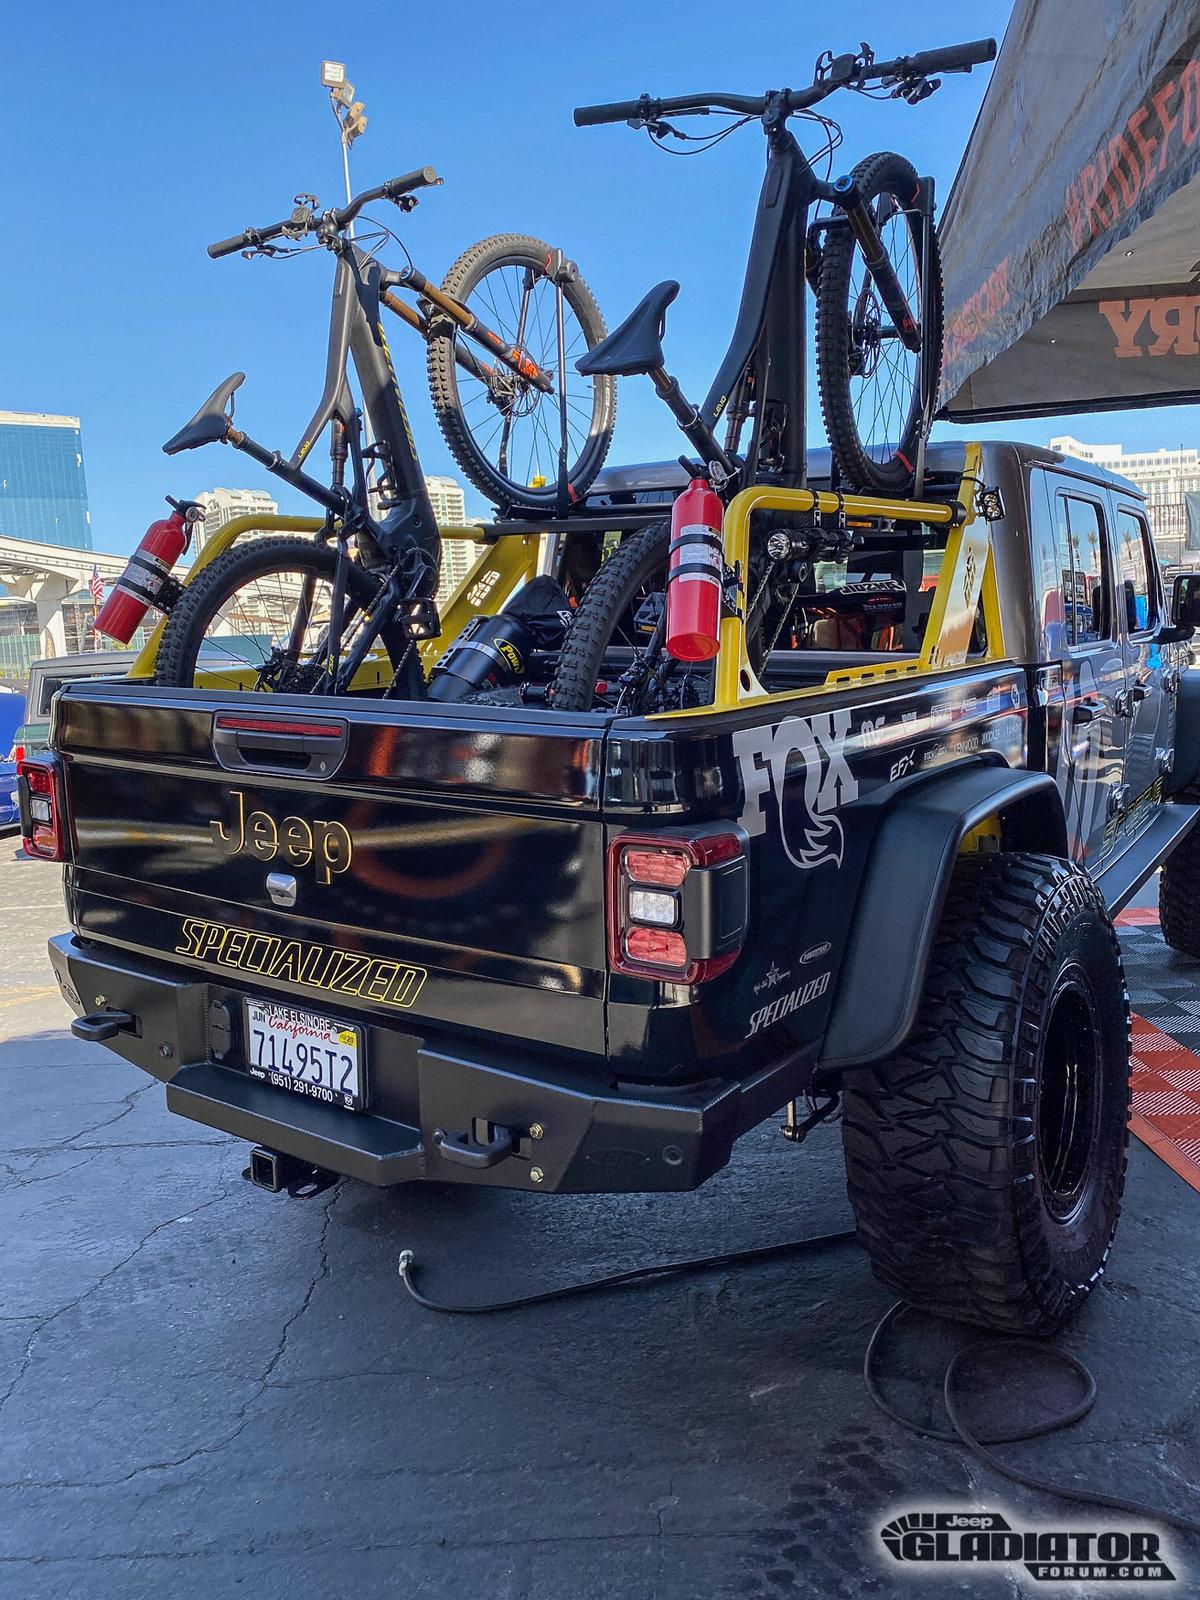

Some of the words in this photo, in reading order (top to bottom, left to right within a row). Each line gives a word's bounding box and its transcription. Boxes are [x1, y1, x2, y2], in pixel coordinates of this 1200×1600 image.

[732, 710, 859, 869] FOX
[890, 749, 915, 782] EFX
[209, 790, 353, 885] Jeep
[175, 917, 428, 1008] SPECIALIZED
[252, 1010, 266, 1023] JUN
[268, 1005, 289, 1021] LAKE
[291, 1010, 331, 1031] ELSINORE
[268, 1015, 340, 1045] California
[745, 971, 831, 1039] SPECIALIZED
[250, 1067, 266, 1080] Jeep
[270, 1071, 292, 1090] (951)
[293, 1079, 333, 1103] 291-9700
[253, 1029, 353, 1095] 71495T2
